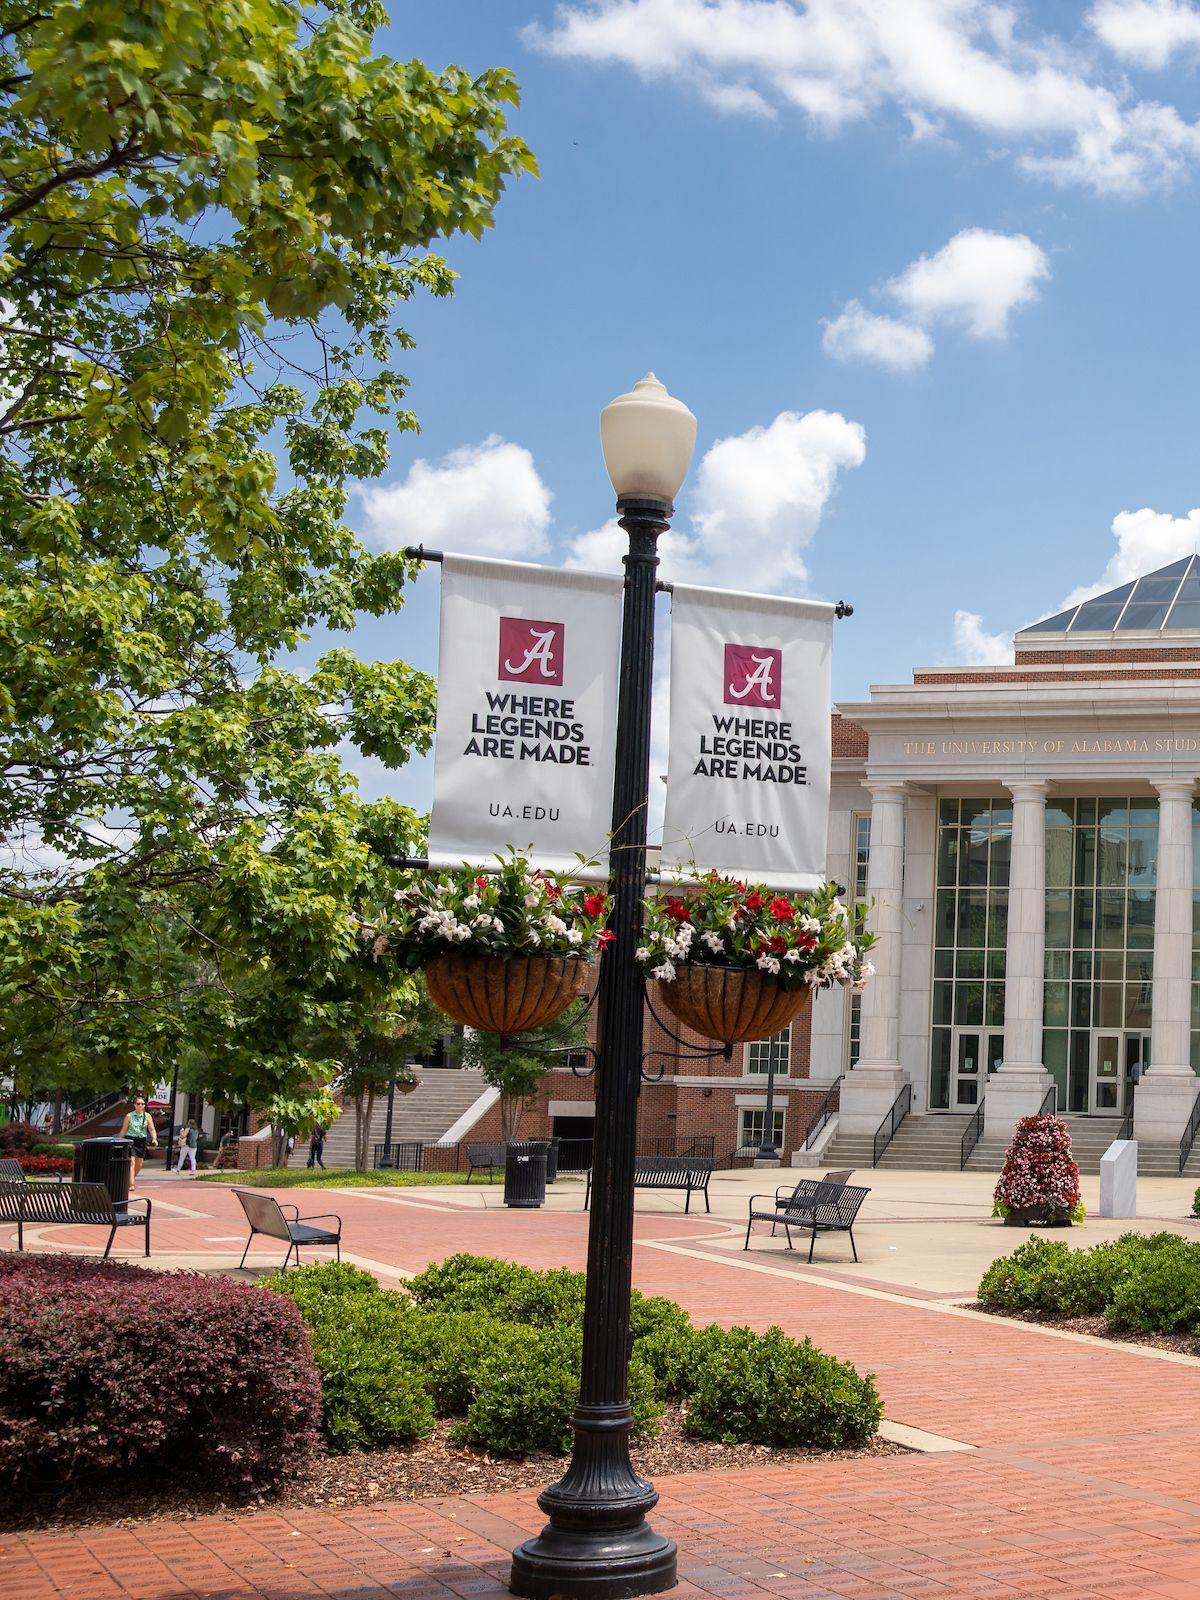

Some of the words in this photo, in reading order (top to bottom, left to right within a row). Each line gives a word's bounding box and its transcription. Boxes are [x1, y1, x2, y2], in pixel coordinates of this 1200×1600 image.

[504, 627, 557, 678] A
[728, 653, 775, 702] A
[485, 691, 576, 720] WHERE
[471, 713, 585, 743] LEGENDS
[711, 714, 792, 742] WHERE
[464, 736, 515, 760] ARE
[699, 735, 802, 764] LEGENDS
[903, 742, 936, 754] THE
[941, 741, 1038, 754] UNIVERSITY
[1043, 740, 1065, 753] OF
[1071, 739, 1149, 753] ALABAMA
[692, 757, 739, 779] ARE
[489, 802, 560, 822] UA.EDU
[714, 820, 780, 838] UA.EDU
